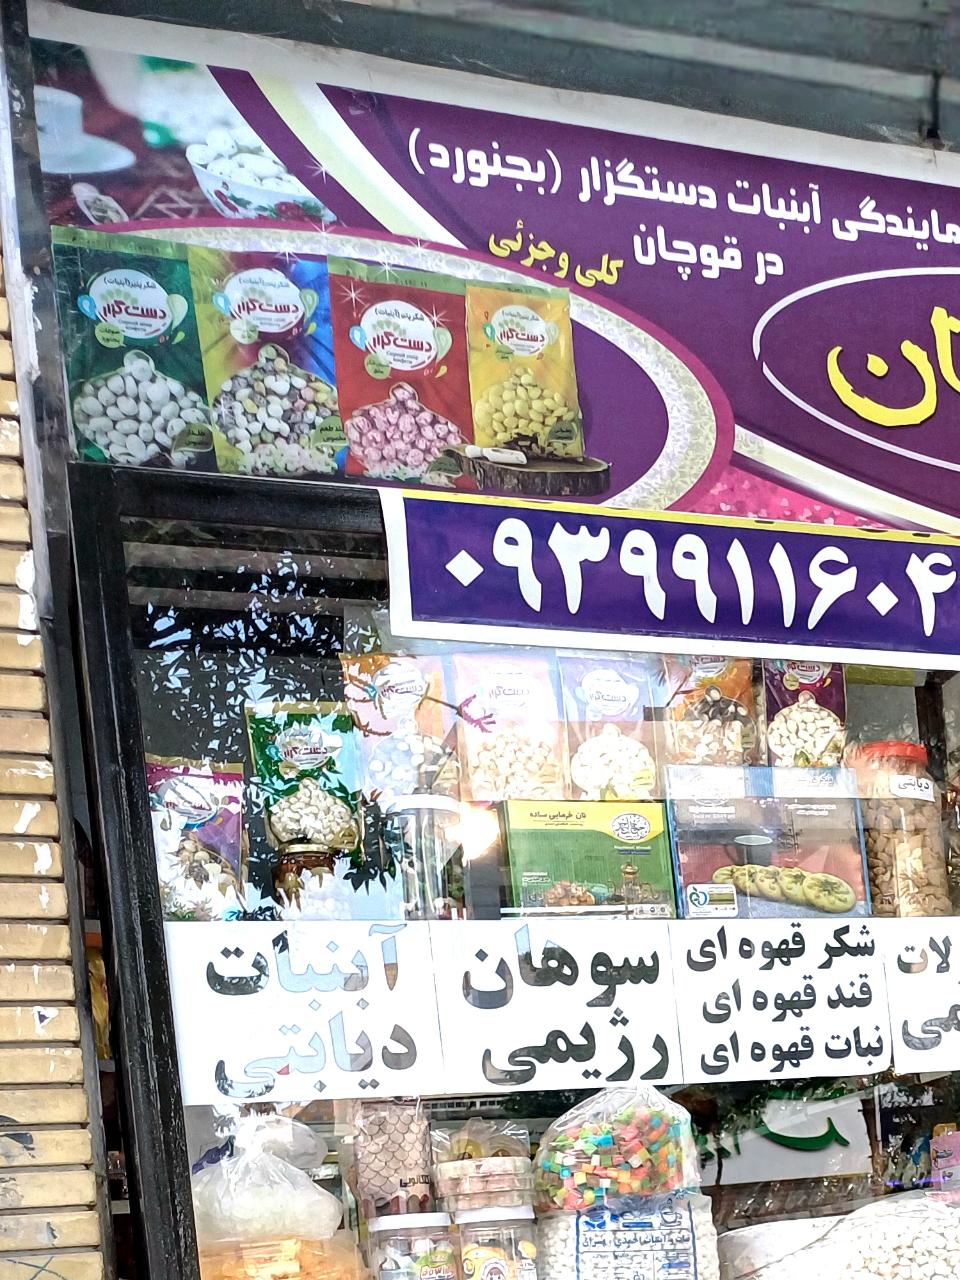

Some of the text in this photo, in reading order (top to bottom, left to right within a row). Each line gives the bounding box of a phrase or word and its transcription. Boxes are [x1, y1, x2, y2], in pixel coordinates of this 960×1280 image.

[408, 127, 562, 195] (بجنورد)
[579, 155, 718, 209] دستگزار
[727, 183, 822, 234] آبنبات
[574, 253, 624, 287] کلی
[633, 223, 785, 285] در قوچان
[206, 923, 408, 1012] آبنبات
[462, 923, 661, 1010] سوهان
[686, 922, 876, 972] شکر قهوه ای
[702, 973, 873, 1024] قند قهوه ای
[214, 1010, 418, 1098] دیابتی
[482, 1007, 670, 1087] رژیمی
[700, 1025, 885, 1076] نبات قهوه ای
